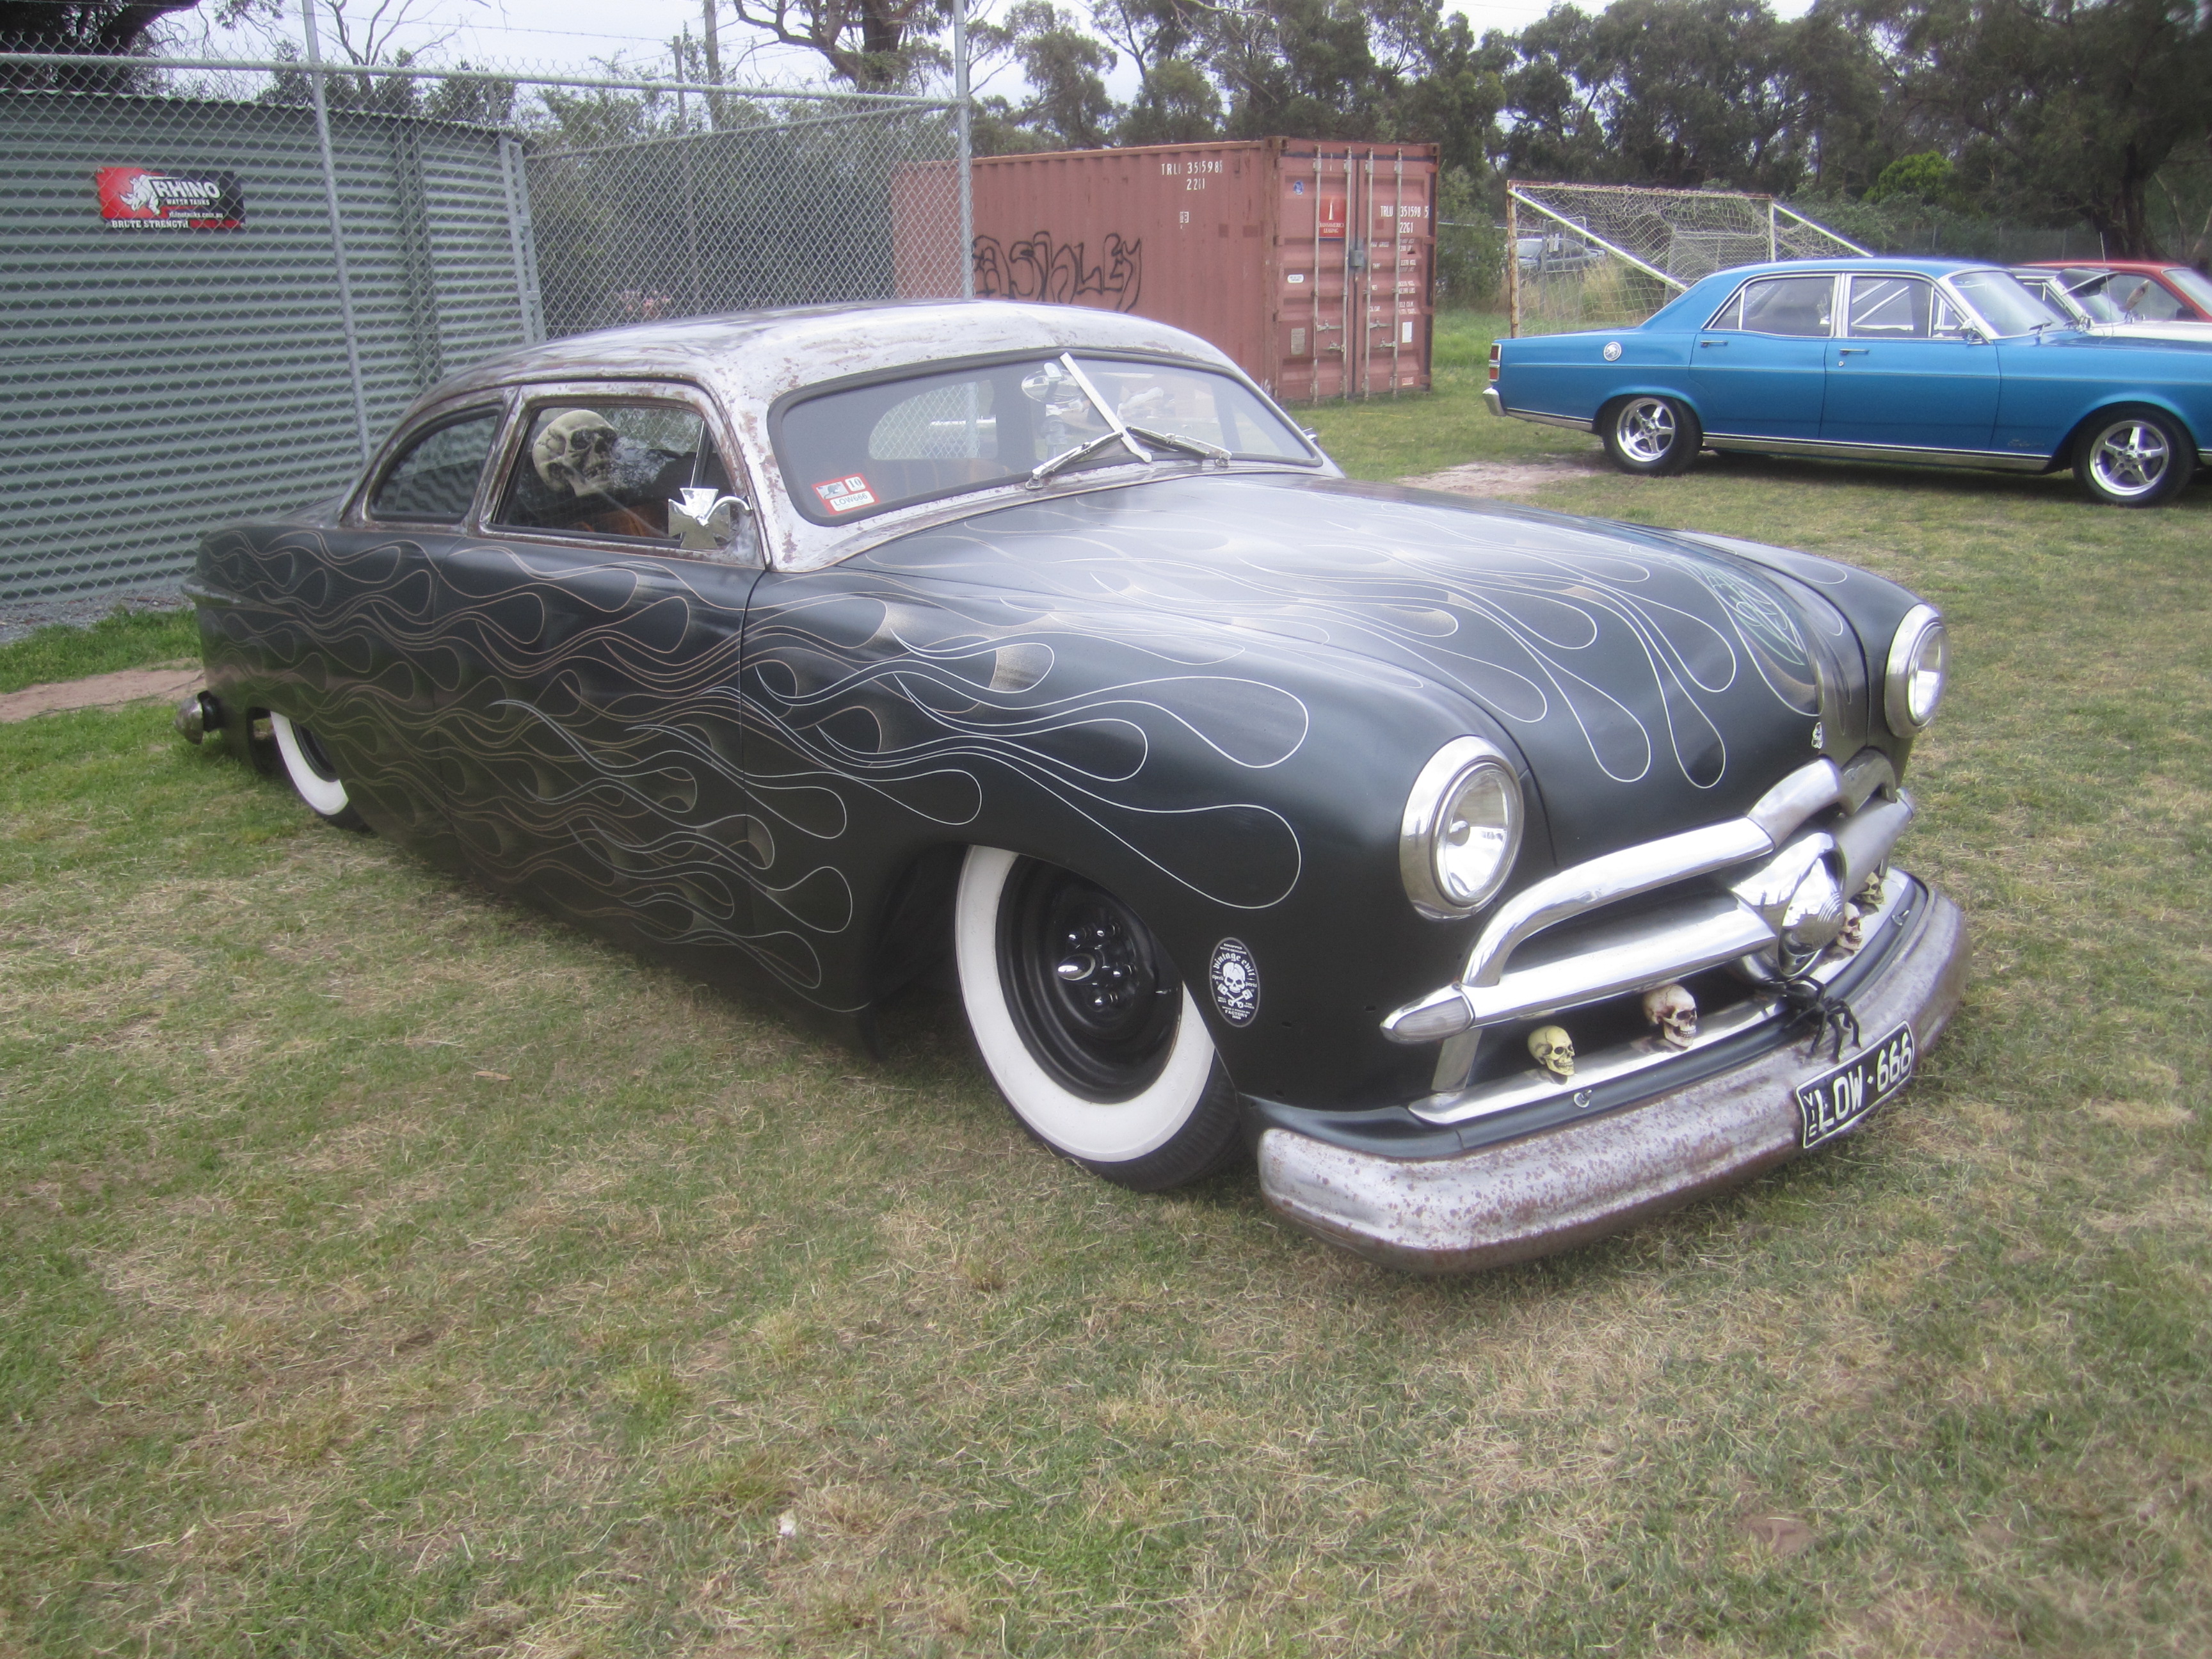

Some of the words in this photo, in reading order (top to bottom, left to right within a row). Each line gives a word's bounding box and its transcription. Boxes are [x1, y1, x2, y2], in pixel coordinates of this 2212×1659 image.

[152, 180, 221, 198] RHINO
[1381, 205, 1393, 217] TRLU
[1400, 205, 1421, 218] 351598
[1399, 222, 1413, 234] 22G1
[848, 477, 862, 488] 10
[833, 493, 868, 506] LOW666
[1213, 952, 1241, 969] vintage
[1241, 959, 1256, 976] evil
[1224, 1009, 1248, 1018] FACTORY
[1803, 1093, 1817, 1137] VIC
